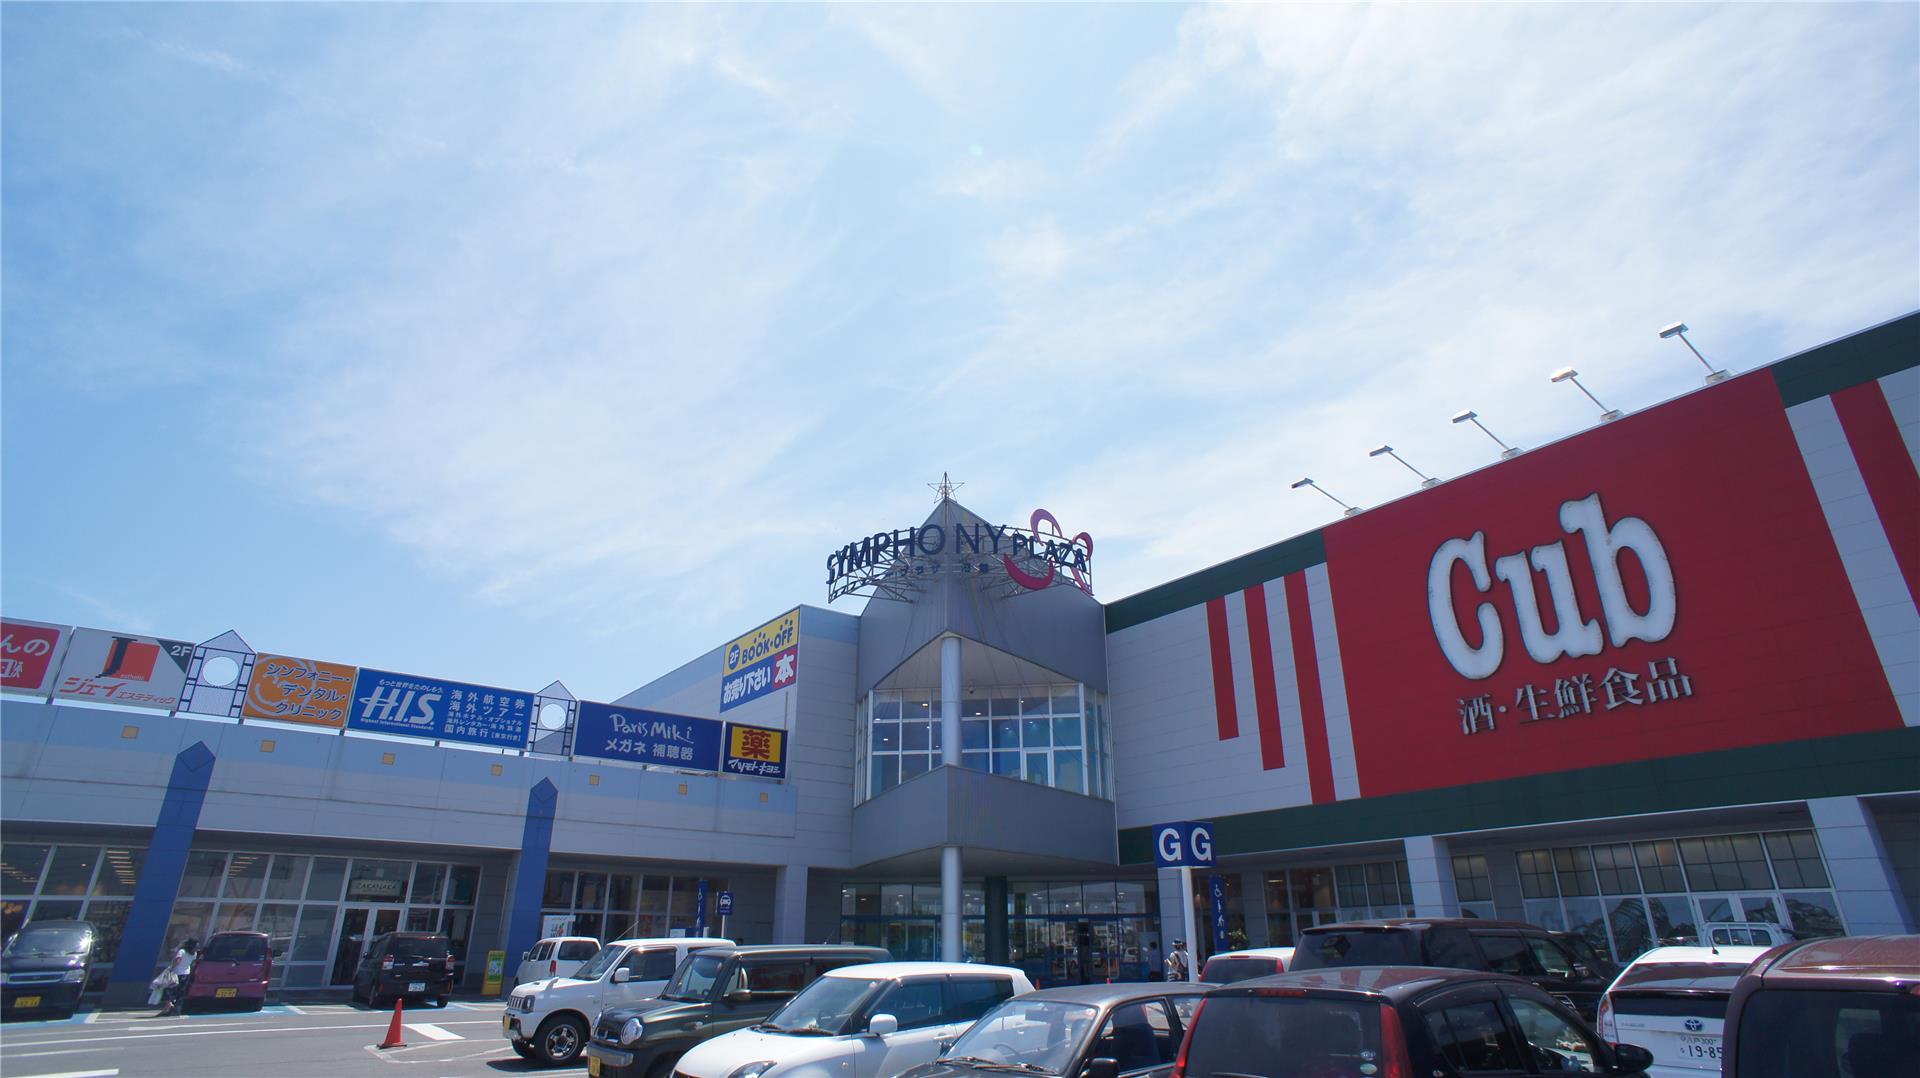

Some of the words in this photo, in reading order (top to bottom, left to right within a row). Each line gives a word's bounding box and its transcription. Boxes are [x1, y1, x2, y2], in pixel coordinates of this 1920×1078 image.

[1012, 533, 1088, 573] PLAZA
[1427, 492, 1676, 680] Cub
[170, 644, 193, 657] 2F
[729, 649, 739, 664] 2F
[59, 677, 128, 697] ジェイ
[723, 666, 771, 704] お売り下さい
[775, 654, 794, 683] 本
[449, 701, 524, 717] 海外ツアー
[450, 689, 525, 709] 海外航空券
[1457, 657, 1693, 735] 酒・生鮮食品
[274, 702, 343, 721] クリニック
[444, 724, 489, 738] 国内旅行
[609, 713, 648, 737] Paris
[650, 721, 694, 744] Miki
[605, 737, 646, 755] メガネ
[652, 743, 694, 761] 補聴器
[741, 729, 771, 759] 薬
[1158, 828, 1182, 861] G
[1191, 827, 1212, 861] G
